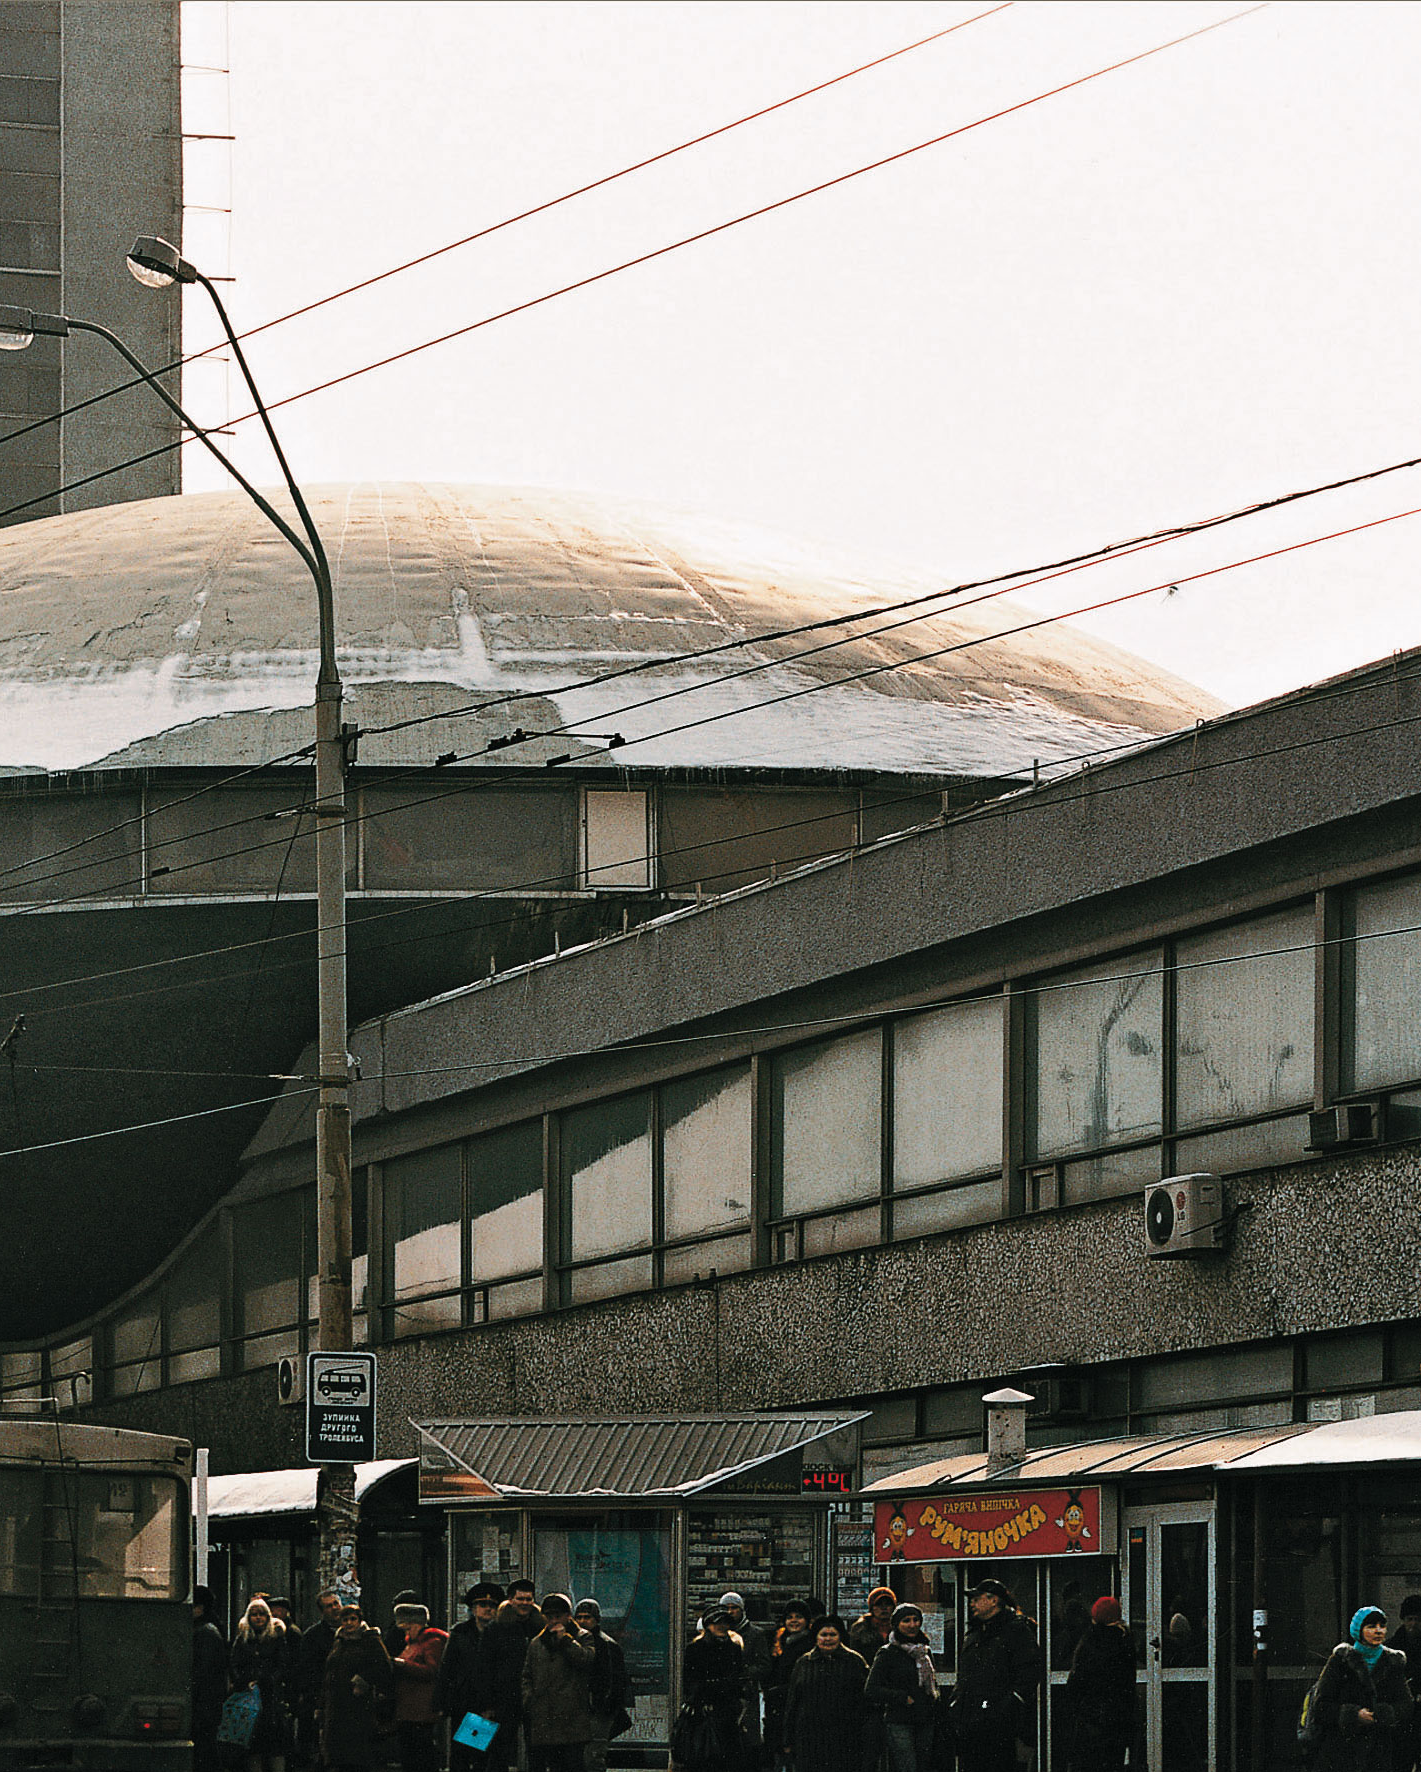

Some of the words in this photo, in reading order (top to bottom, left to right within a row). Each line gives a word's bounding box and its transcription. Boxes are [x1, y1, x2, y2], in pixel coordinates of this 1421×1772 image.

[1177, 1210, 1186, 1221] LG
[322, 1413, 361, 1423] ЗУПИНКА
[320, 1423, 357, 1433] ДРУГОГО
[943, 1501, 978, 1515] ГАРЯЧА
[980, 1498, 1021, 1512] ВИПІЧКА
